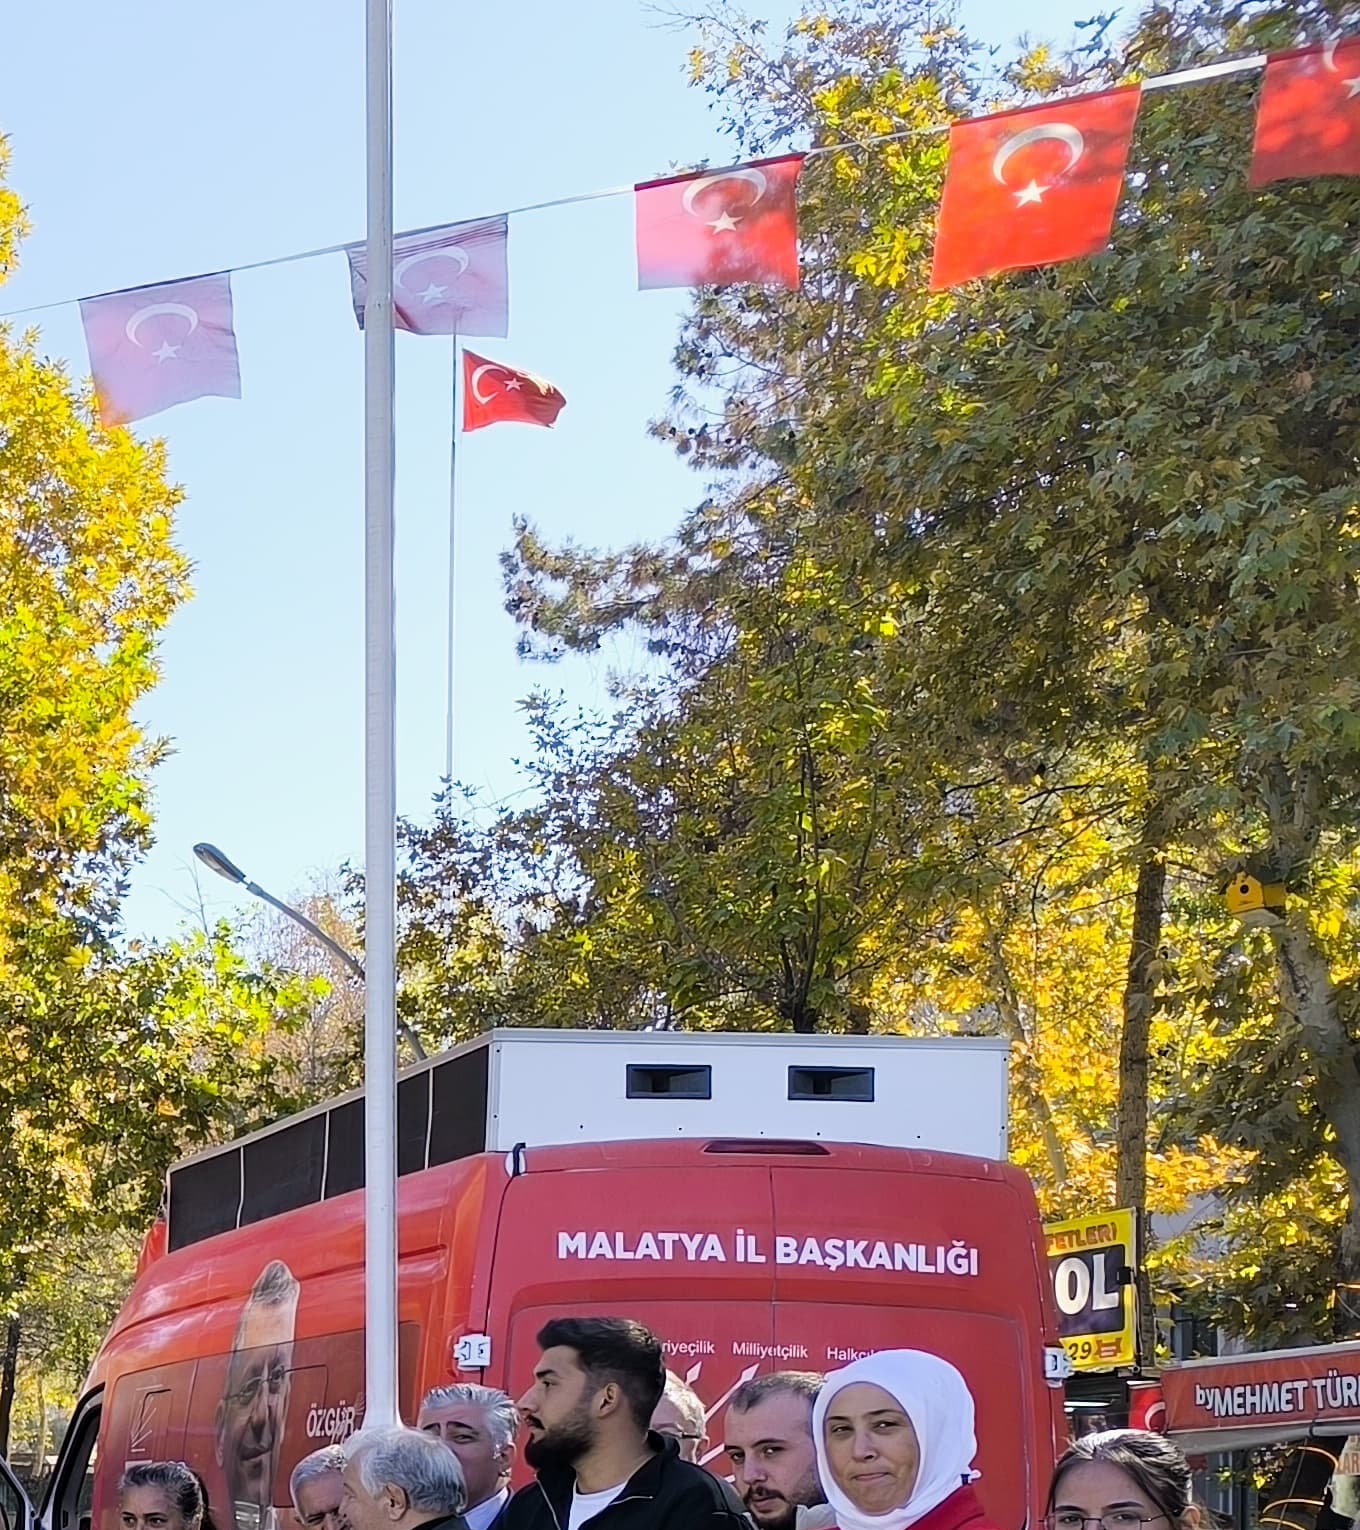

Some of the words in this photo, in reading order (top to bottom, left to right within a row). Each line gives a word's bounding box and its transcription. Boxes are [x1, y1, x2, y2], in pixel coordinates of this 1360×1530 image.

[558, 1231, 727, 1262] MALATYA
[736, 1228, 767, 1263] İL
[775, 1236, 979, 1276] BAŞKANLIĞI
[1312, 1370, 1360, 1409] TÜR
